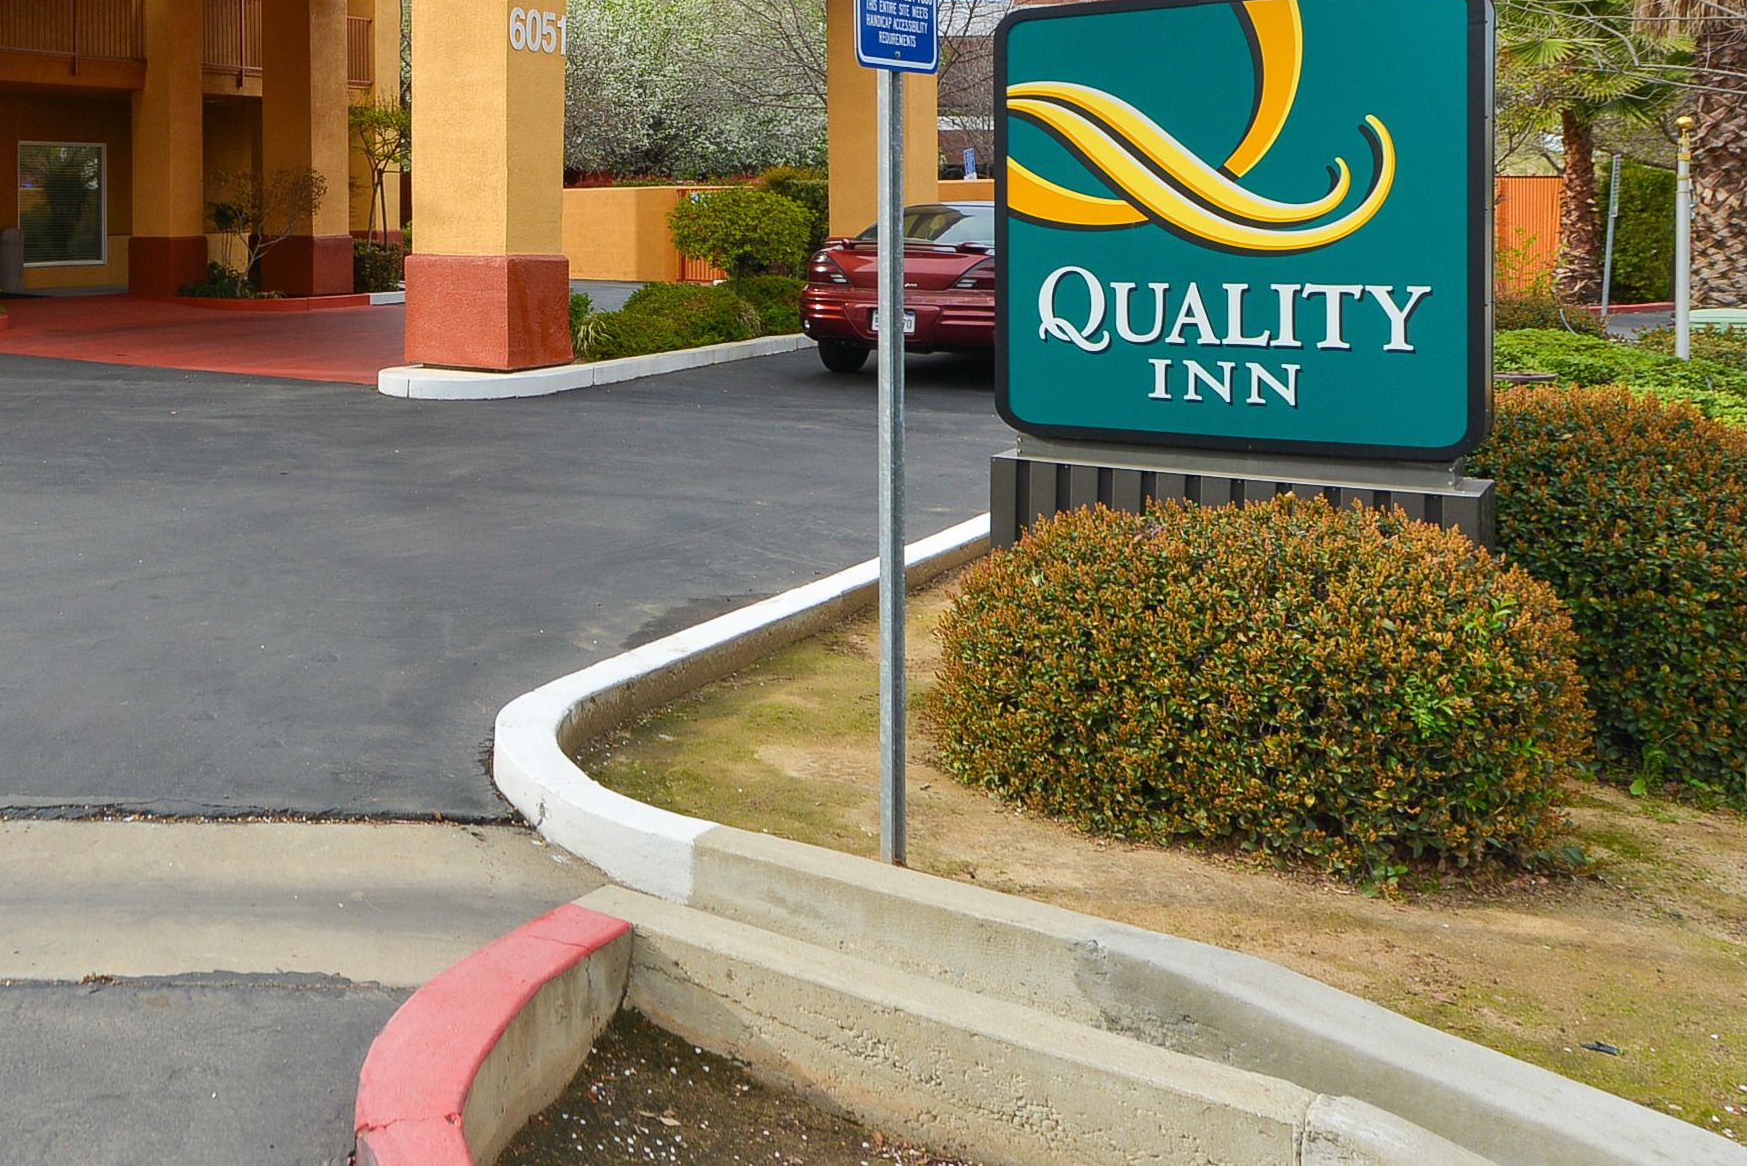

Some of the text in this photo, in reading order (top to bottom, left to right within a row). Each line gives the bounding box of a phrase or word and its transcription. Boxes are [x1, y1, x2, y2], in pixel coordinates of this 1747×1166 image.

[866, 14, 927, 34] HANDICAP ACCESSIBILITY
[879, 0, 897, 15] ENTIRE
[899, 3, 910, 16] SITE
[912, 6, 928, 19] MEETS
[509, 6, 566, 56] 6051
[879, 31, 916, 47] REQUIREMENTS
[1038, 265, 1432, 352] QUALITY
[1148, 358, 1301, 407] INN
